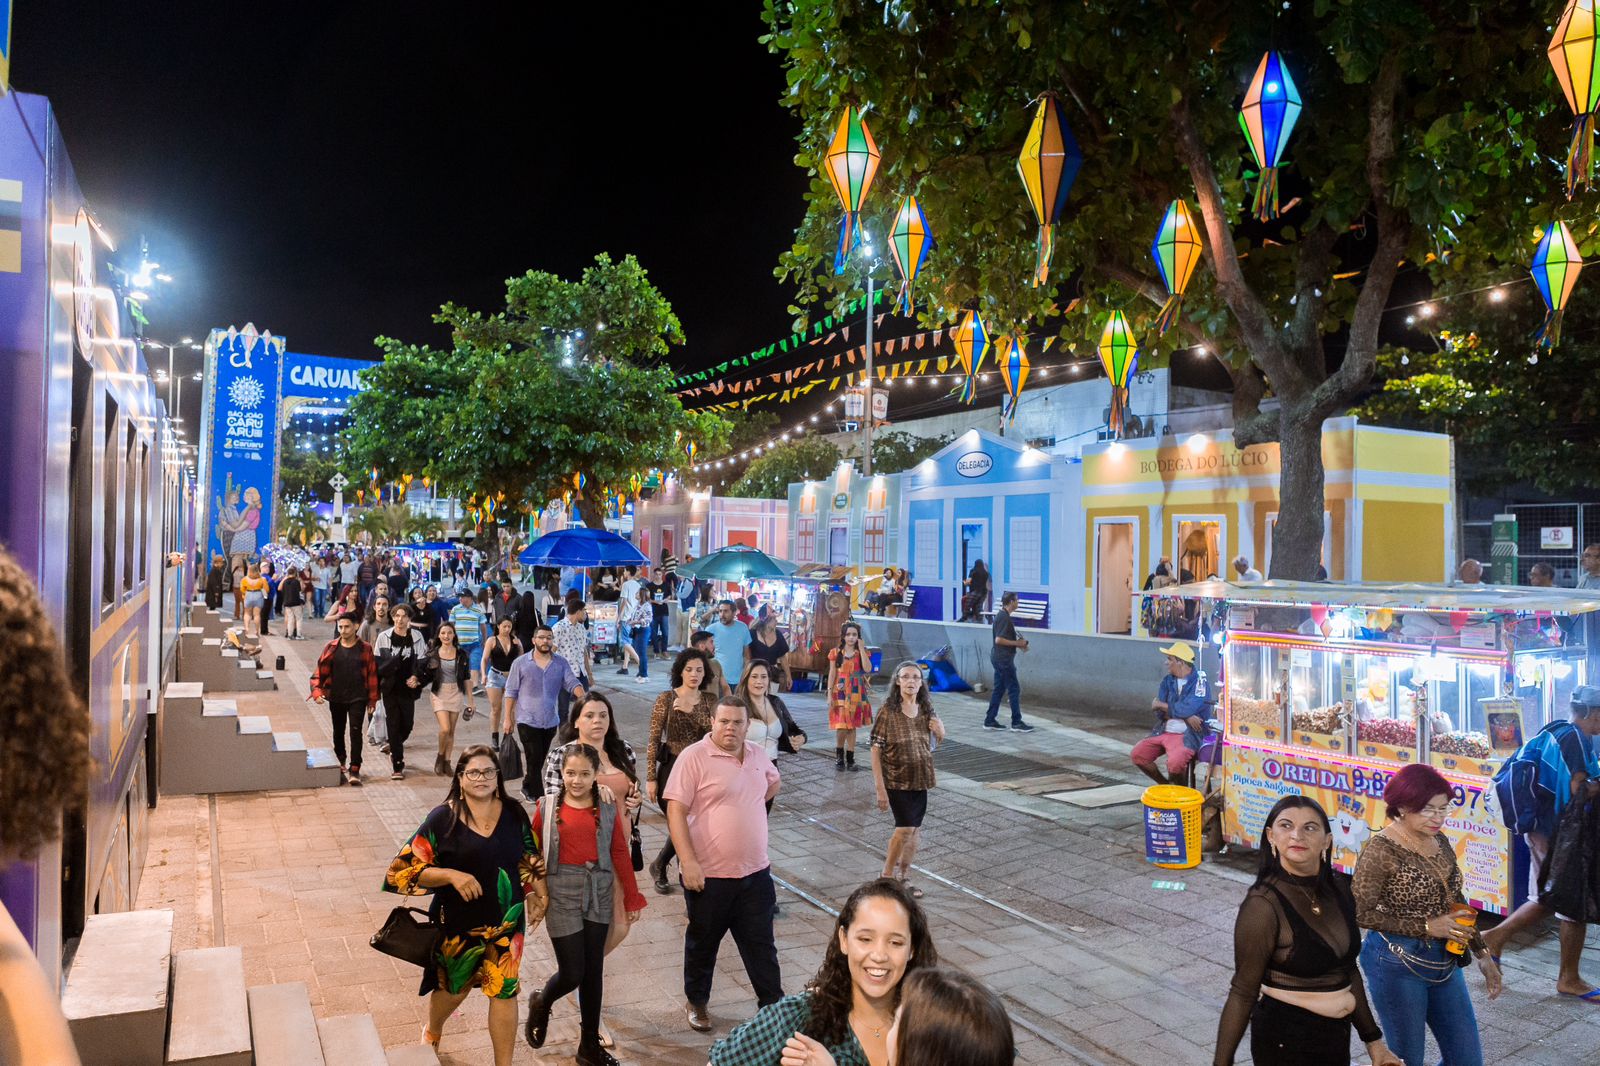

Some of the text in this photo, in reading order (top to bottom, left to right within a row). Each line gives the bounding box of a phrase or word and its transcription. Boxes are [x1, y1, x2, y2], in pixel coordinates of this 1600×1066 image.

[290, 366, 371, 391] CARUAR
[227, 417, 263, 428] CARU
[233, 440, 263, 448] Caruaru
[958, 459, 990, 470] DELEGACIA
[1140, 450, 1268, 473] BODEGA DO LÚCIO
[1264, 759, 1281, 778] O
[1284, 764, 1317, 784] REI
[1320, 770, 1350, 791] DA
[1233, 774, 1301, 795] Pipoca Salgada
[1463, 821, 1496, 836] Doce
[1467, 840, 1497, 851] Laranja
